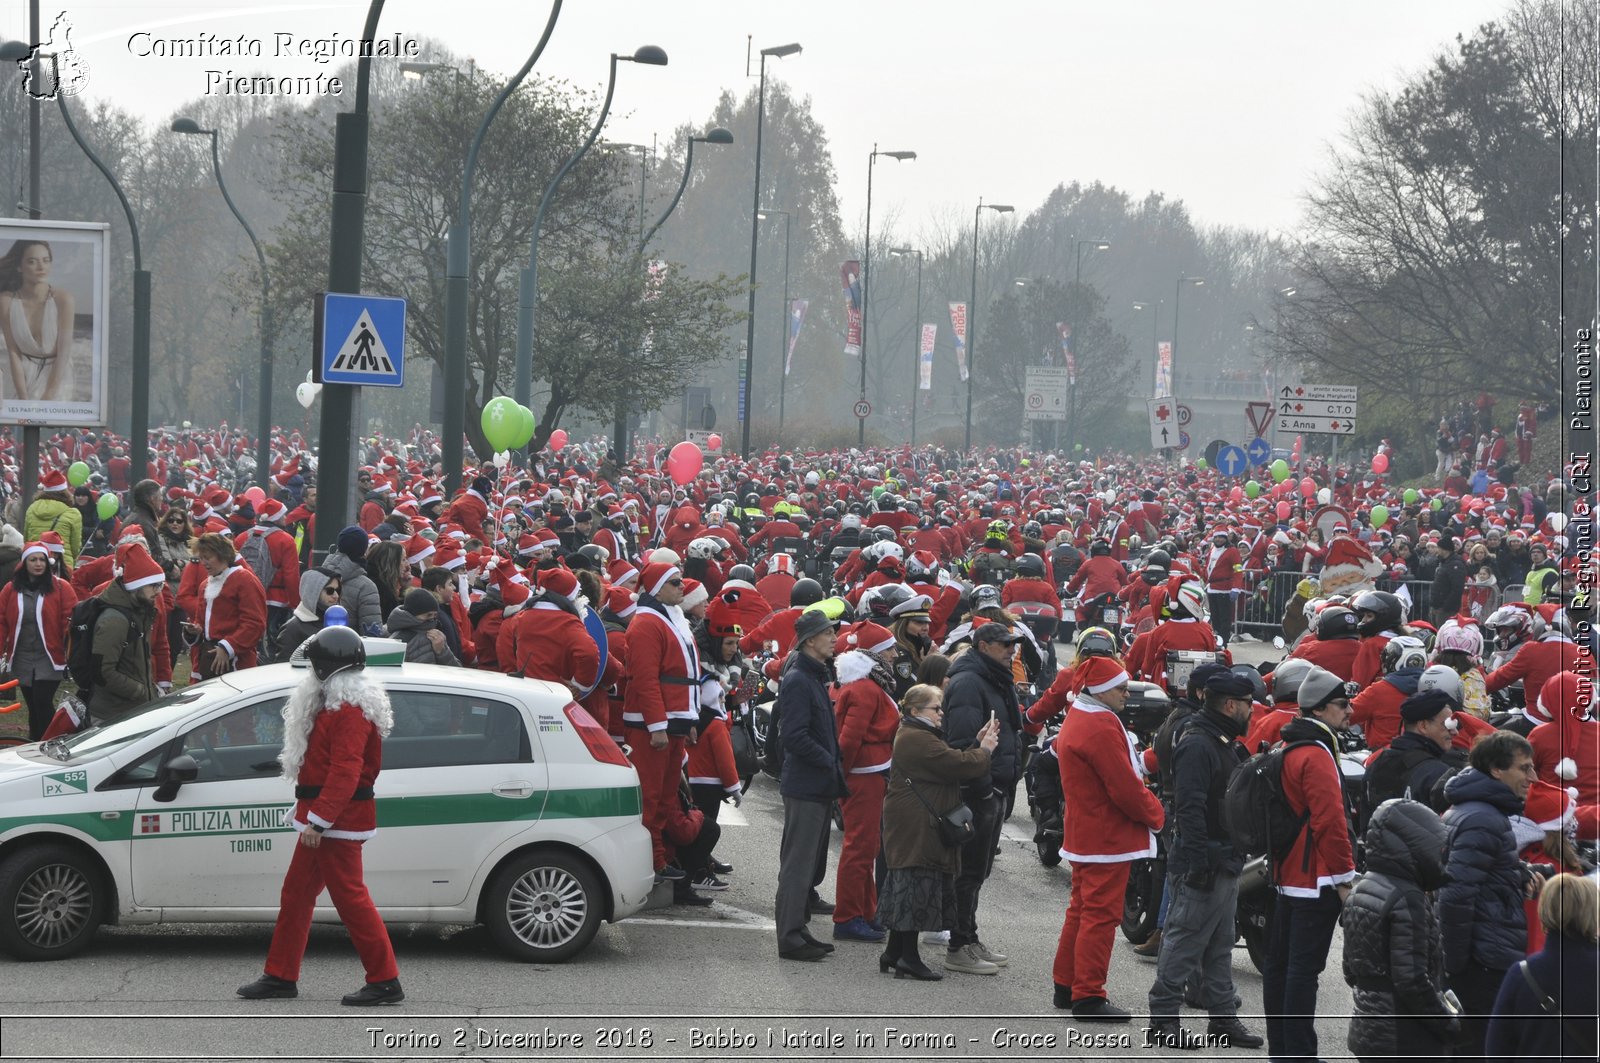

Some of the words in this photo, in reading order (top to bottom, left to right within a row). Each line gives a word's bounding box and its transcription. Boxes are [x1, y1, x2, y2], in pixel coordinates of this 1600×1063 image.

[858, 404, 868, 414] 70
[1327, 405, 1354, 414] C.T.O.
[1281, 420, 1289, 428] S.
[1293, 420, 1316, 429] Anna
[64, 771, 86, 782] 552
[172, 811, 233, 832] POLIZIA
[240, 809, 294, 830] MUNIC
[229, 838, 272, 853] TORINO
